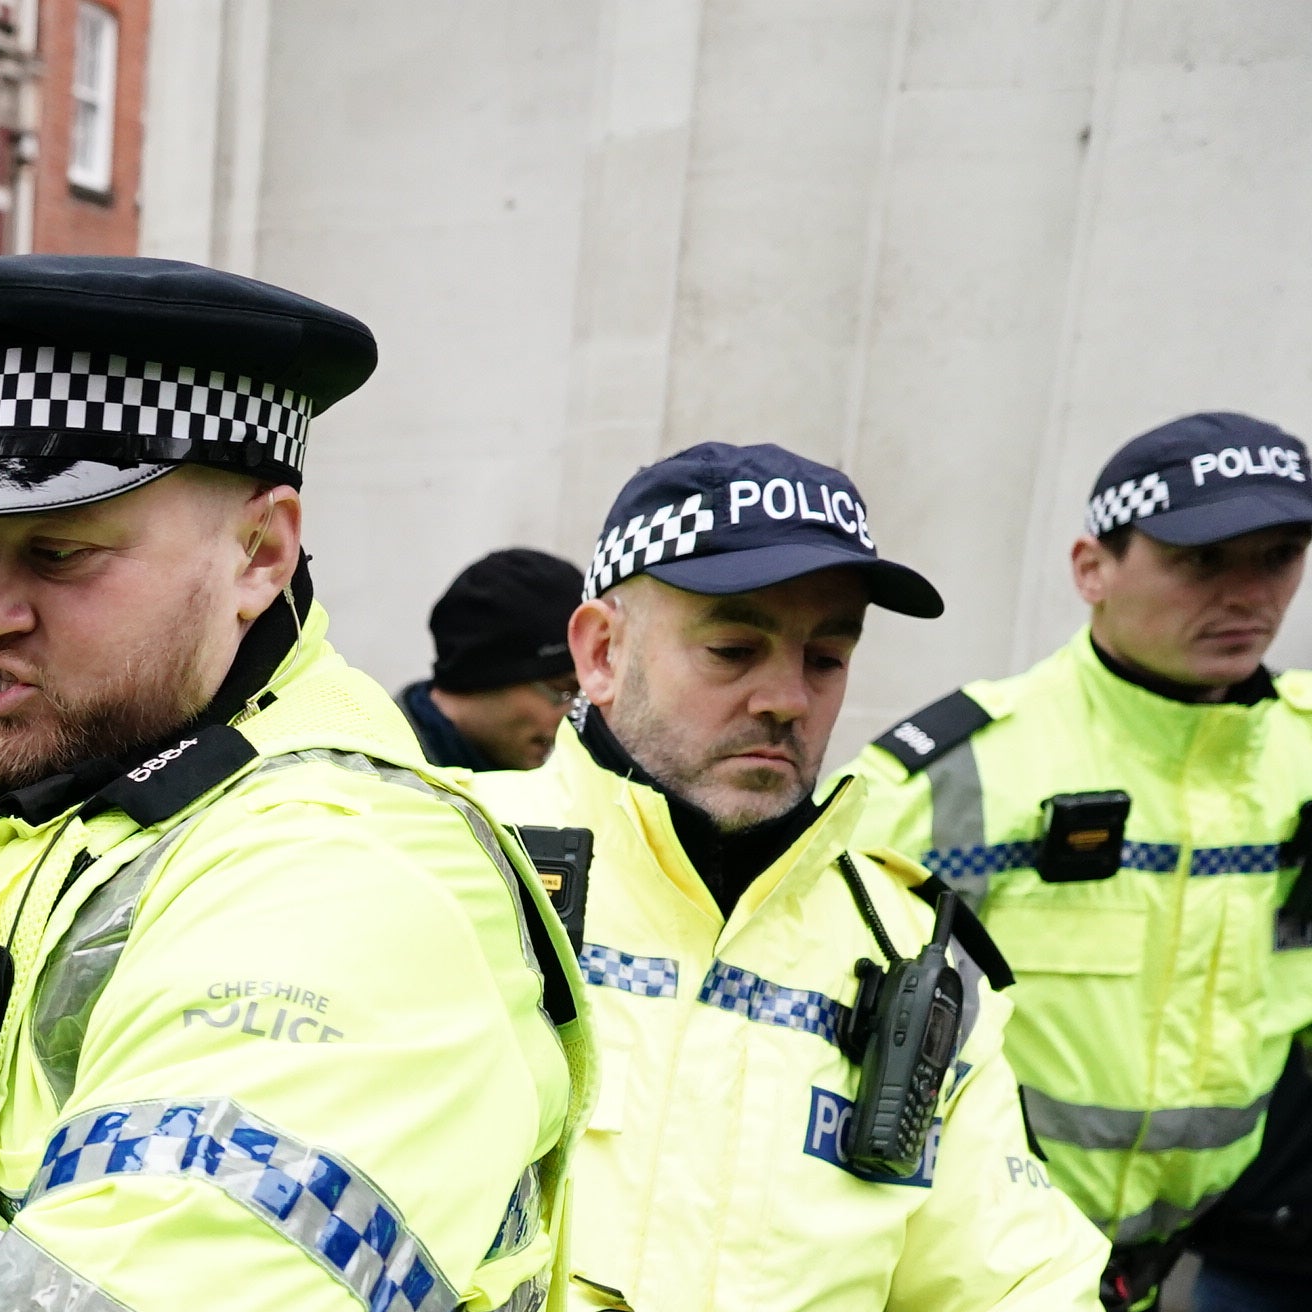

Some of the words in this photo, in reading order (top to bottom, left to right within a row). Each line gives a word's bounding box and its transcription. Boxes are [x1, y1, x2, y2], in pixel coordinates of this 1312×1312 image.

[1191, 445, 1307, 487] POLICE
[729, 477, 875, 550] POLICE
[126, 737, 198, 783] 5884
[206, 980, 330, 1015] CHESHIRE
